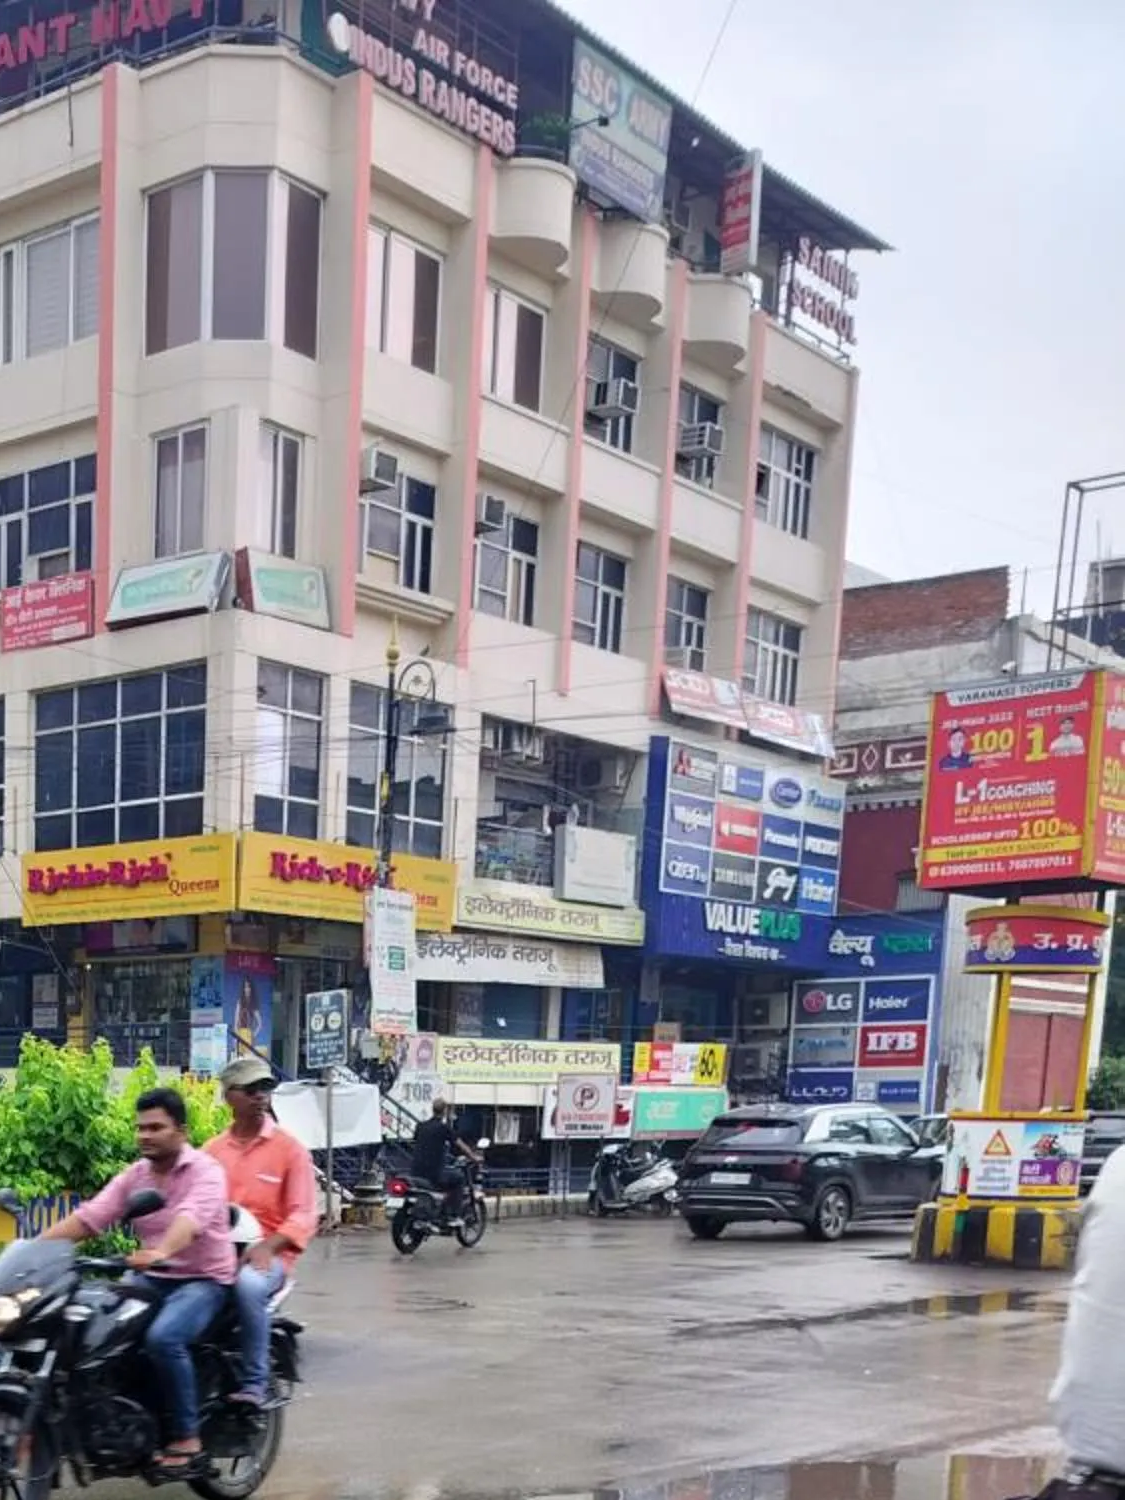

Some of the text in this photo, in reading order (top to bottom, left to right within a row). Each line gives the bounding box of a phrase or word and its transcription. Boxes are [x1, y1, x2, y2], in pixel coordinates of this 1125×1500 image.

[412, 28, 520, 111] AIR FORCE
[577, 56, 619, 117] SSC
[348, 24, 517, 157] INDUS RANGERS
[791, 279, 859, 346] SCHOOL
[970, 727, 1014, 753] 100
[1025, 722, 1049, 763] 1
[1018, 817, 1078, 840] 100%
[826, 993, 853, 1011] LG
[868, 996, 911, 1009] Haier
[443, 1041, 558, 1068] इलेक्ट्रॉनिक
[866, 1032, 918, 1050] IFB
